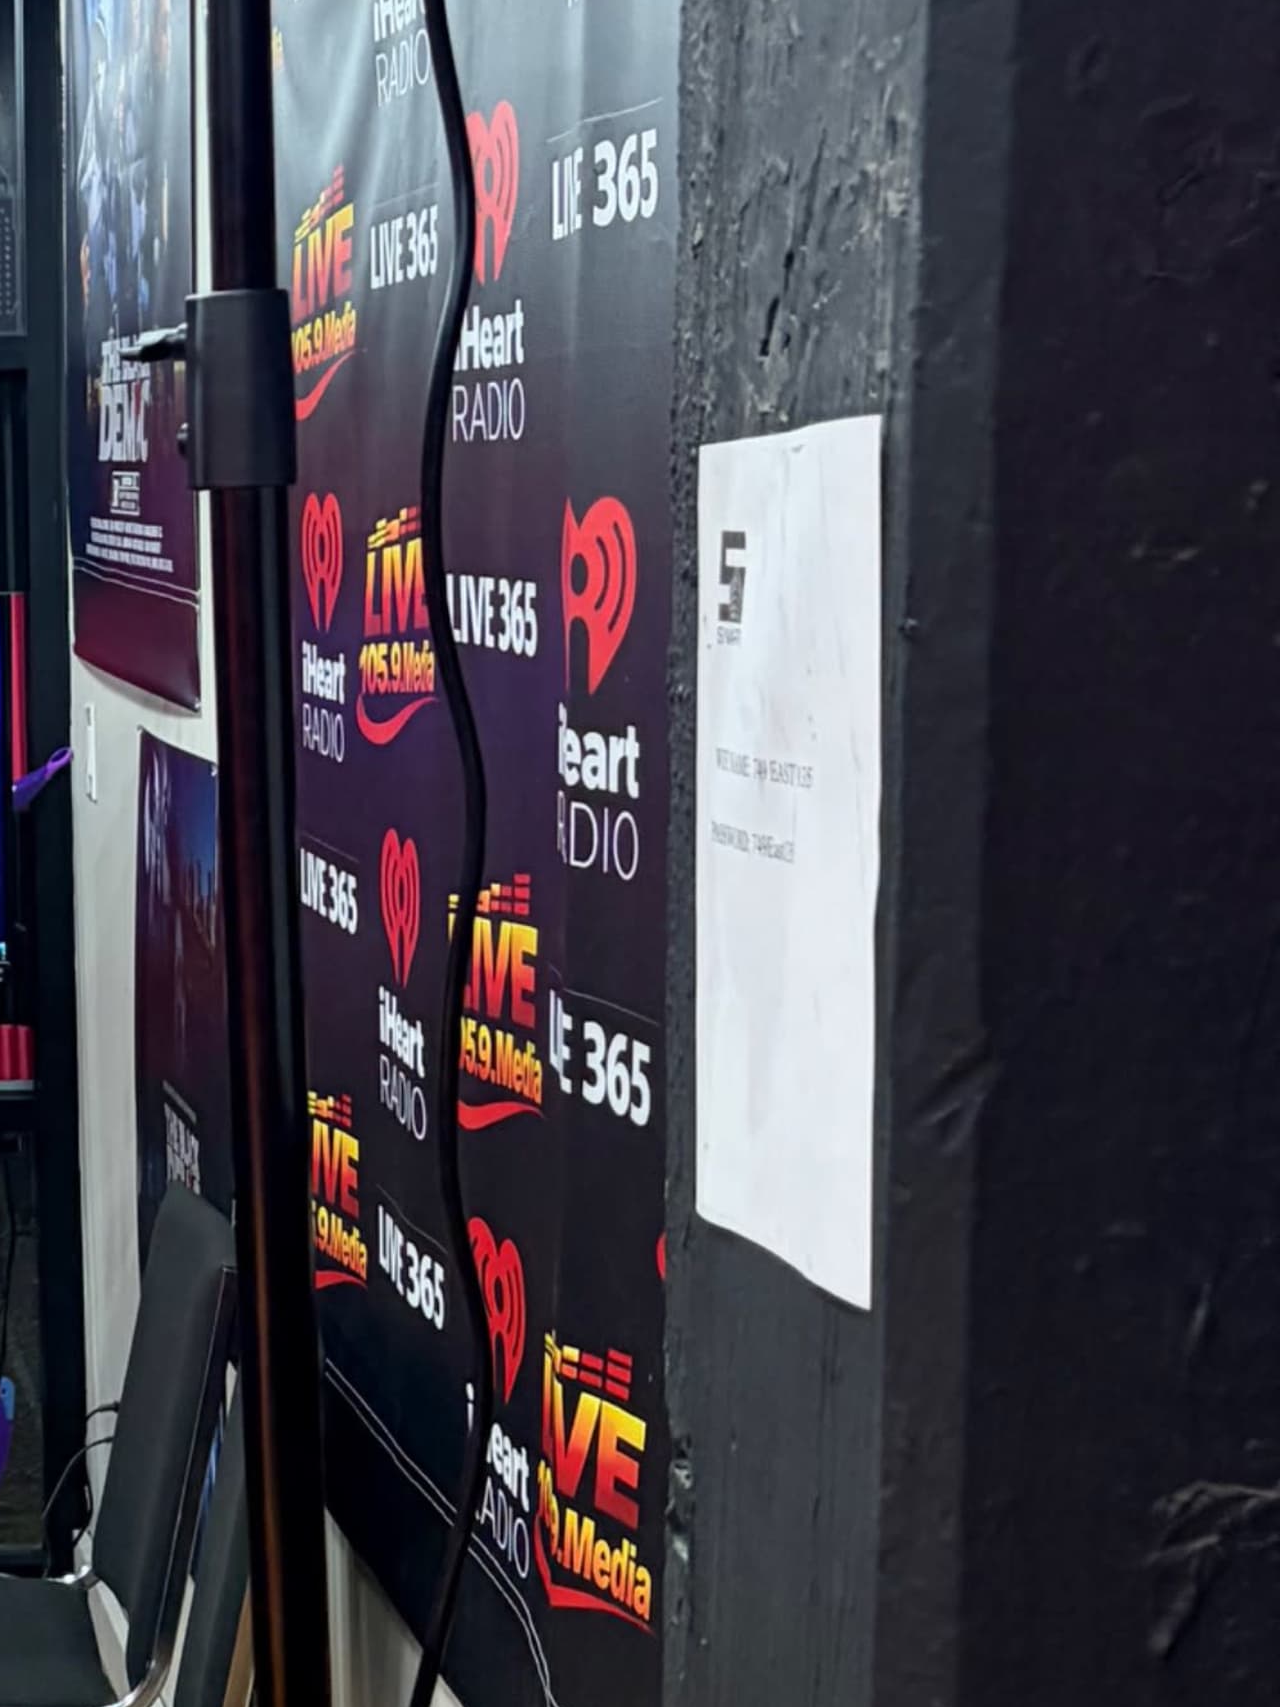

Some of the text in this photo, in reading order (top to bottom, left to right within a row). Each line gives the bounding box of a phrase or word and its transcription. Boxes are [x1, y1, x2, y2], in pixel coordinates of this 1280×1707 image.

[375, 28, 431, 107] RADIO
[592, 127, 659, 227] 365
[292, 203, 355, 325] LIVE
[370, 203, 439, 290] LIVE 365
[452, 377, 526, 443] RADIO
[446, 573, 539, 658] LIVE 365
[302, 640, 347, 705] iHeart
[302, 702, 346, 764] RADIO
[300, 847, 359, 935] LIVE 365
[378, 985, 426, 1079] iHeart
[582, 1020, 652, 1127] 365
[379, 1053, 427, 1140] RADIO
[310, 1119, 360, 1220] IVE
[405, 1241, 446, 1331] 365
